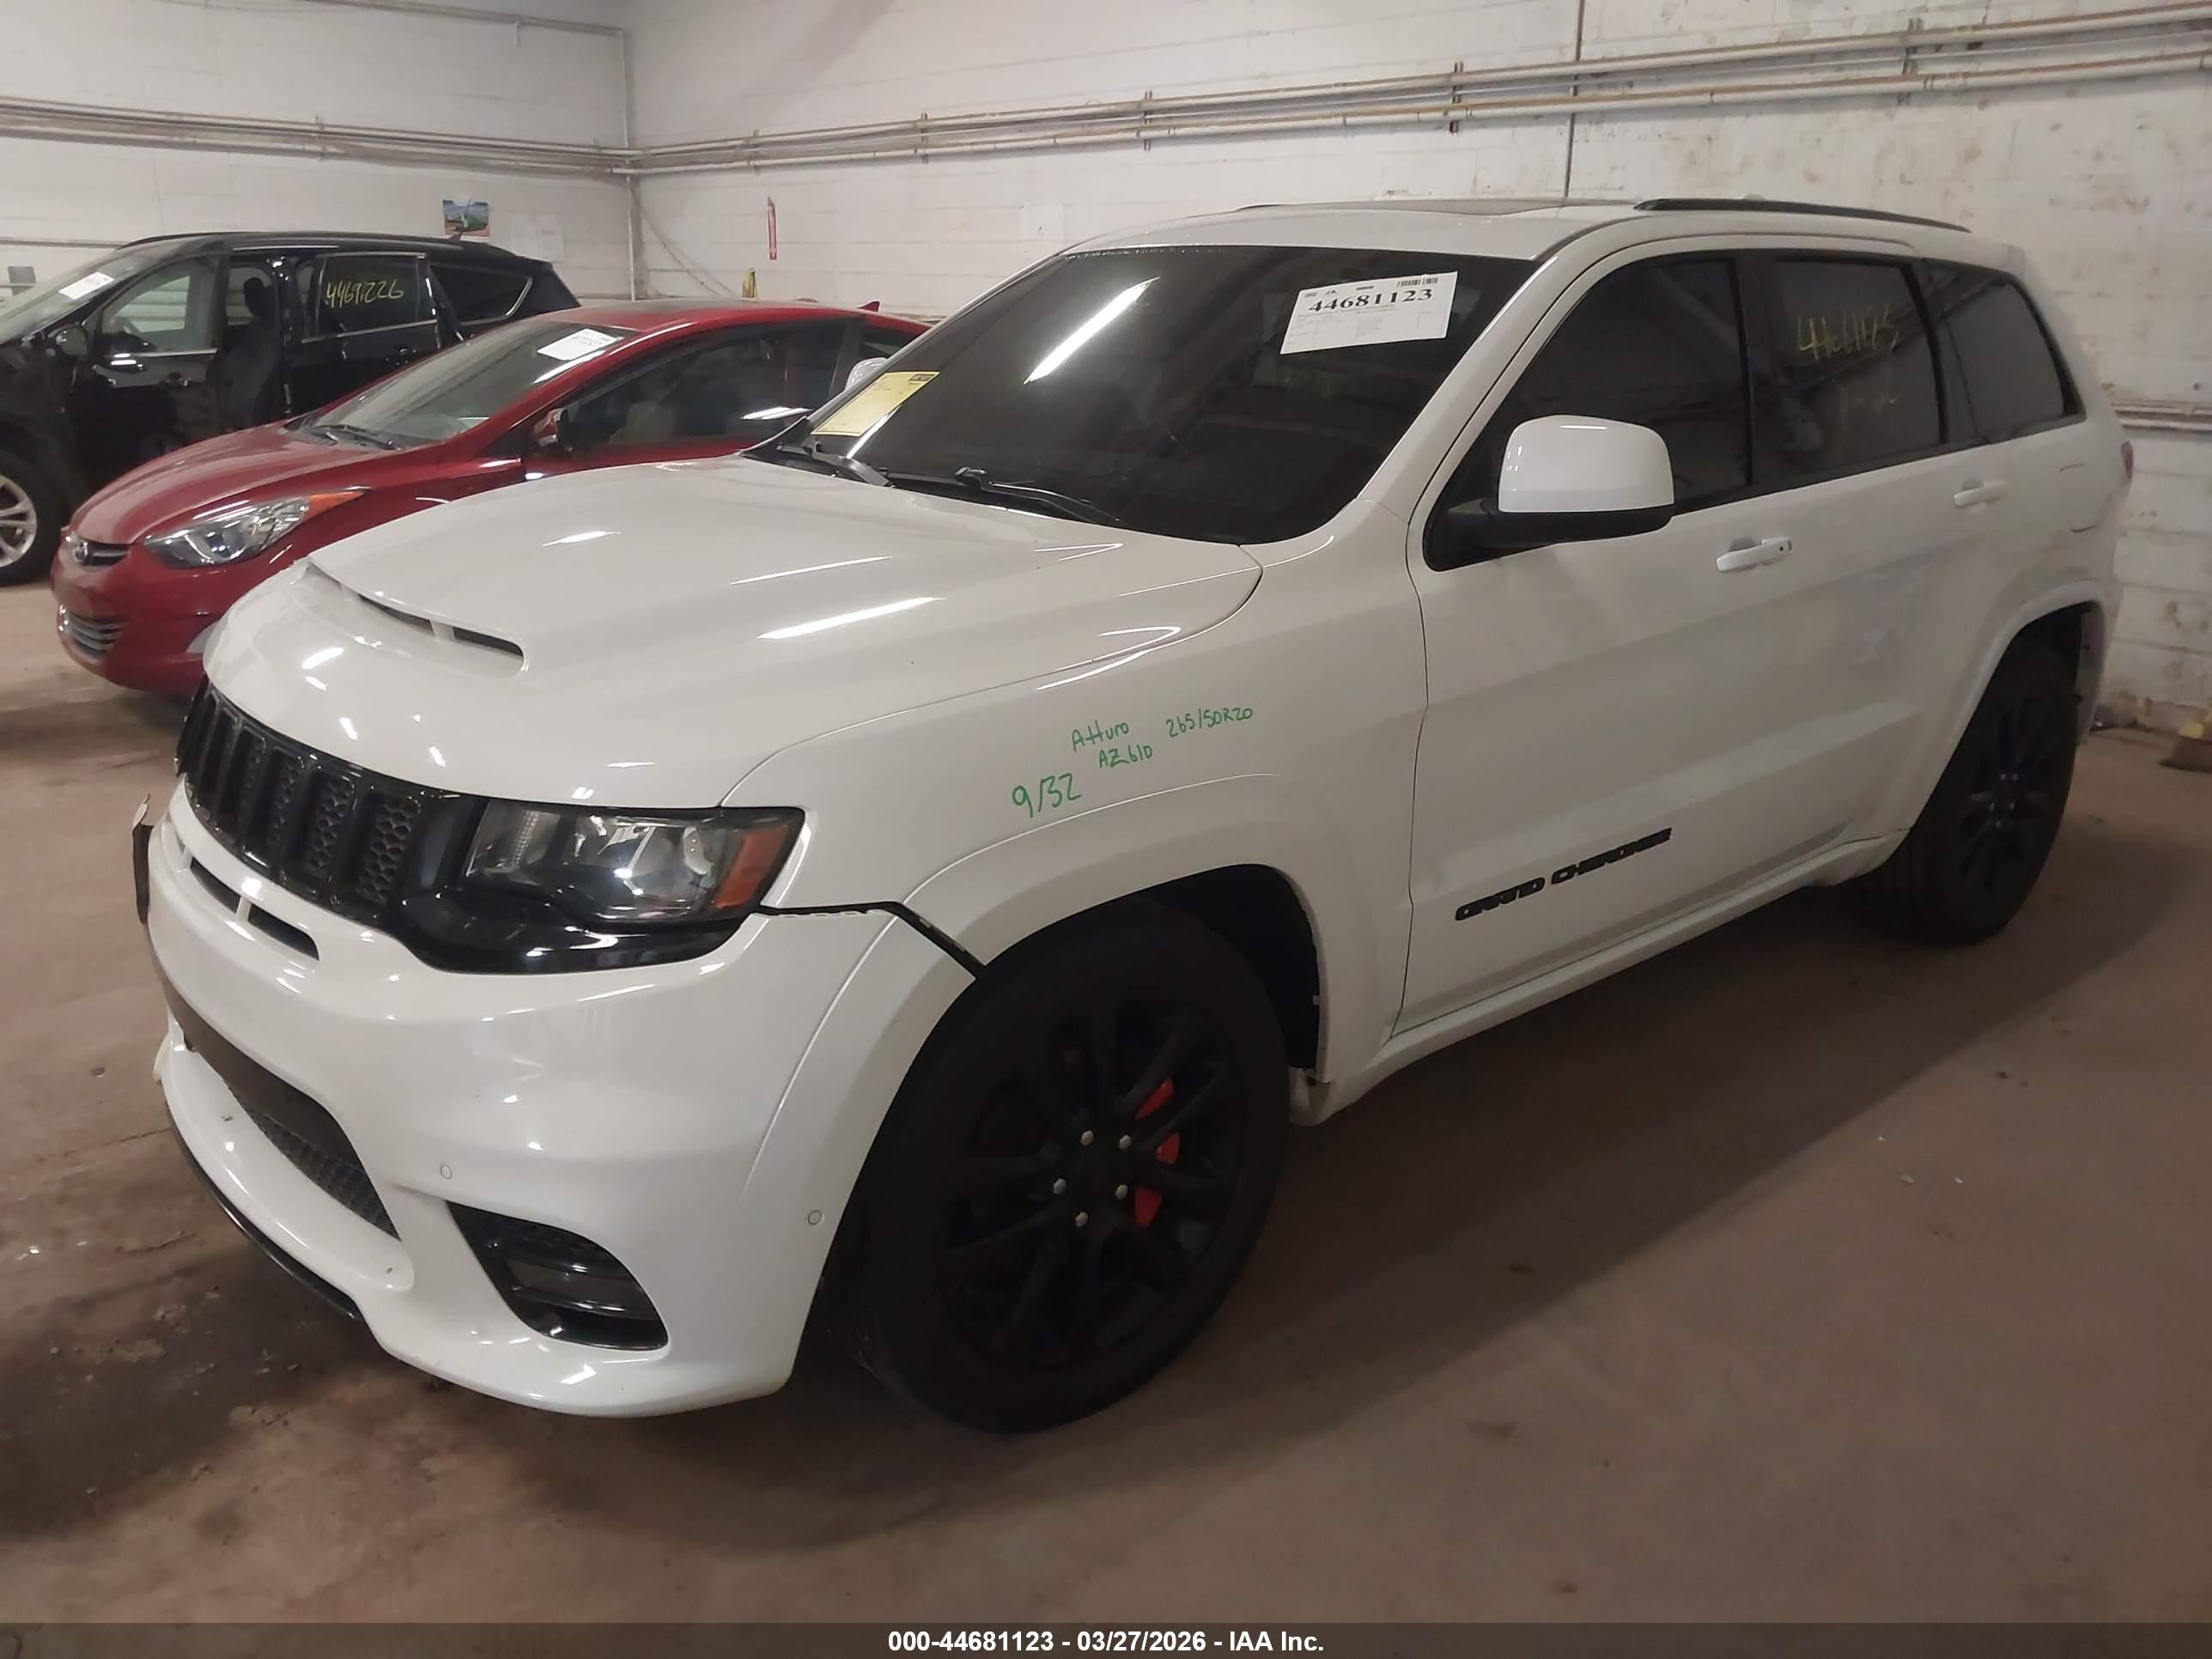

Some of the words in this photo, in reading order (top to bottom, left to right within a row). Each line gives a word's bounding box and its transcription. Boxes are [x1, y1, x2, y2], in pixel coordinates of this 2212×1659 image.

[1308, 289, 1432, 312] 44681123
[1166, 708, 1253, 738] 265/50R20
[1012, 773, 1082, 817] 9/32
[1455, 877, 1545, 921] GRAND
